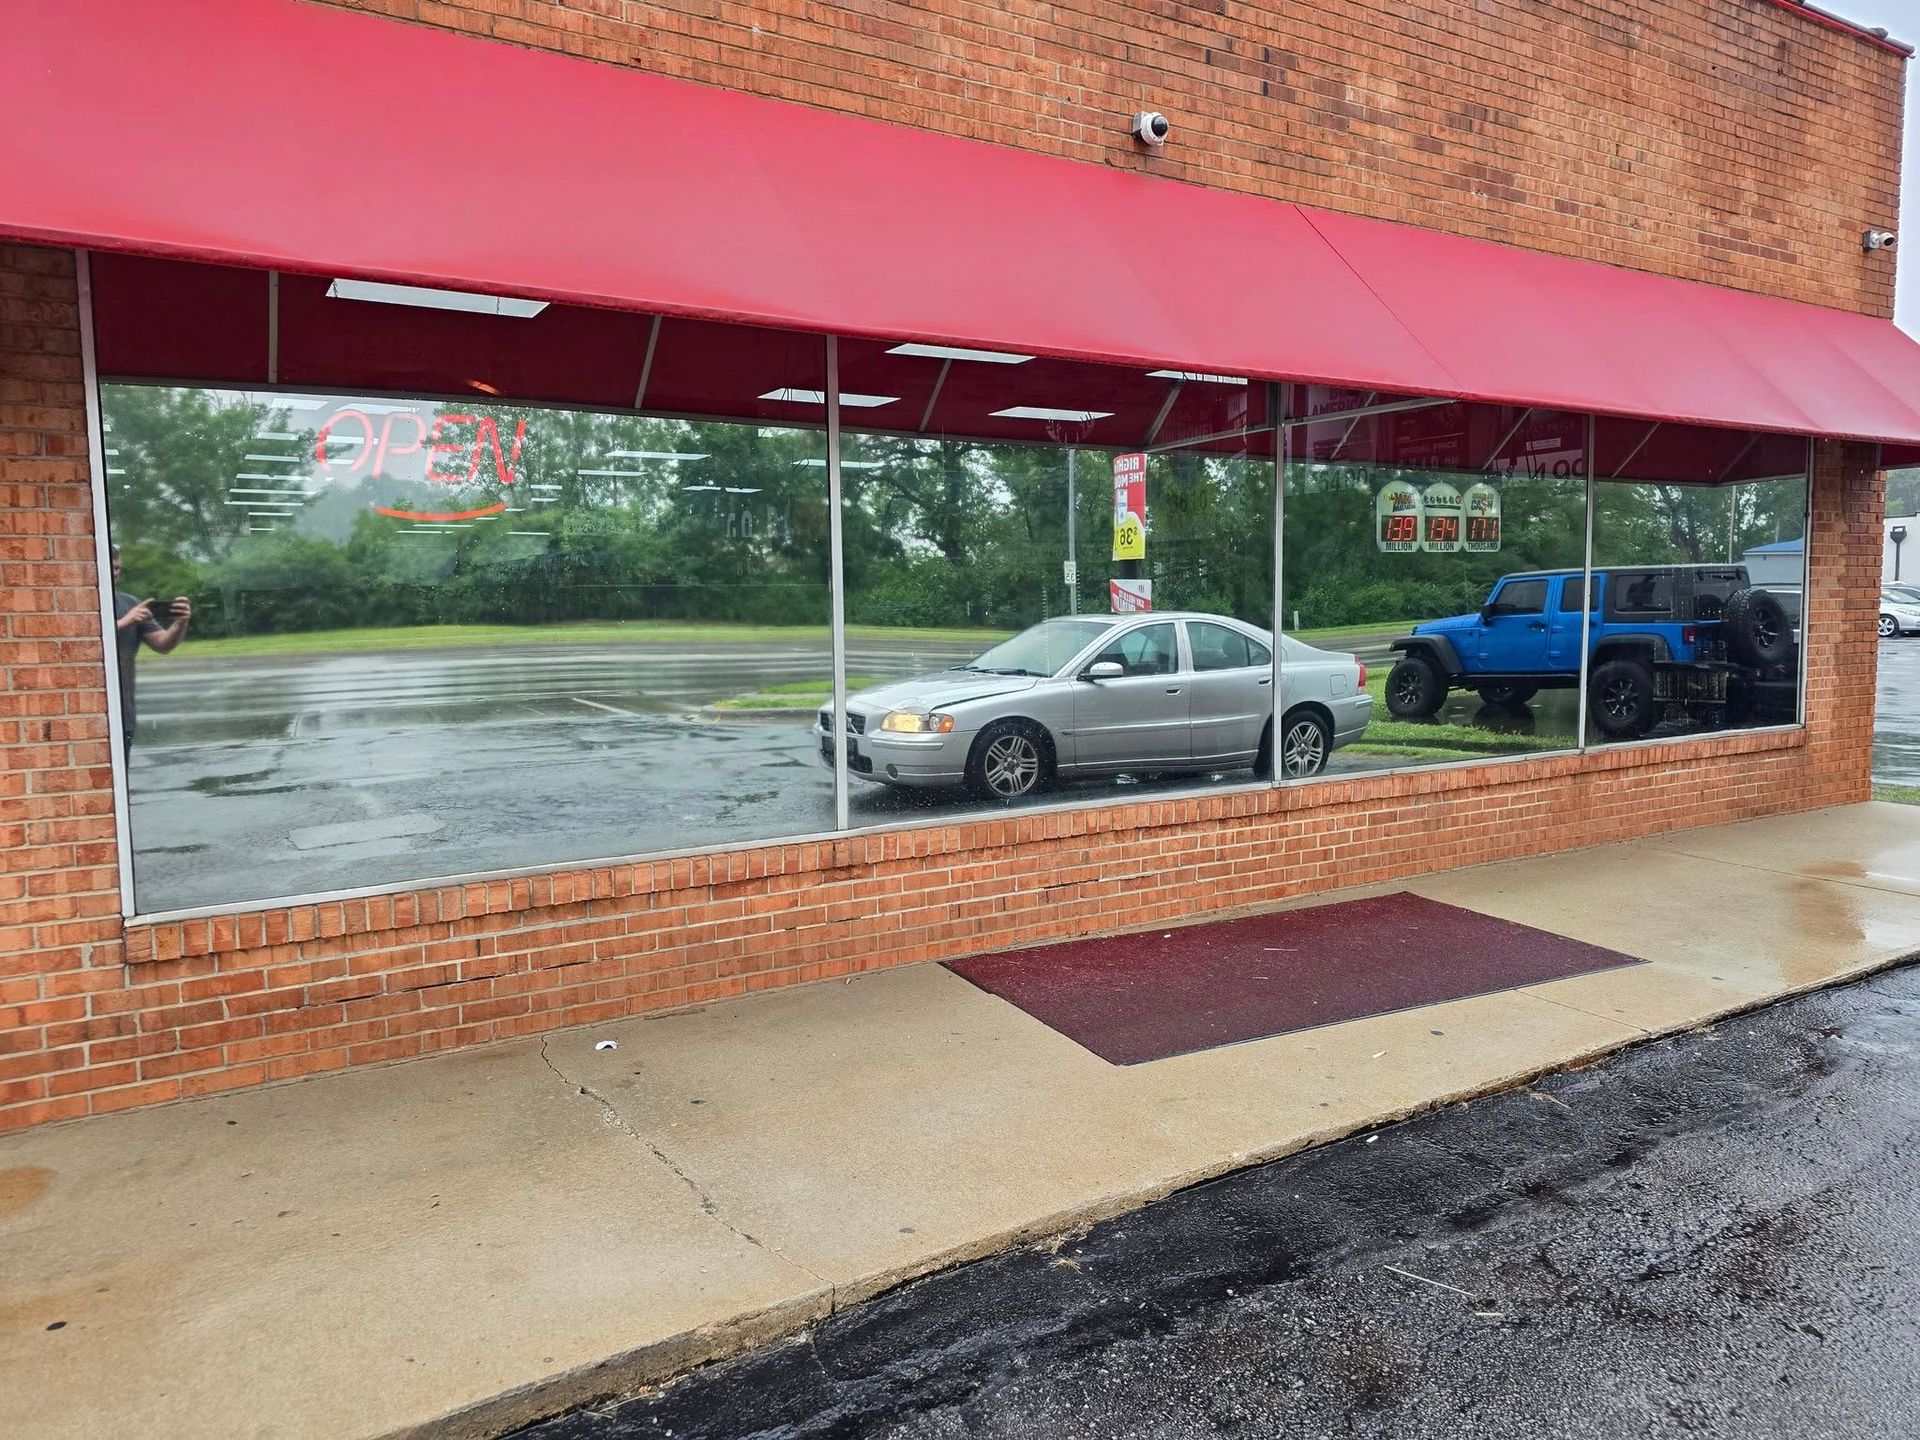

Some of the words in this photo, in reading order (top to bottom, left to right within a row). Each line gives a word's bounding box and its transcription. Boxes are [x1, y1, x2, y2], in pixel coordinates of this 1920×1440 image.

[314, 408, 527, 484] OPEN
[1387, 517, 1415, 541] 139
[1430, 517, 1456, 541] 134
[1471, 518, 1497, 540] 171
[1386, 542, 1413, 551] MILLION
[1428, 542, 1455, 551] MILLION
[1468, 542, 1498, 551] THOUSAND
